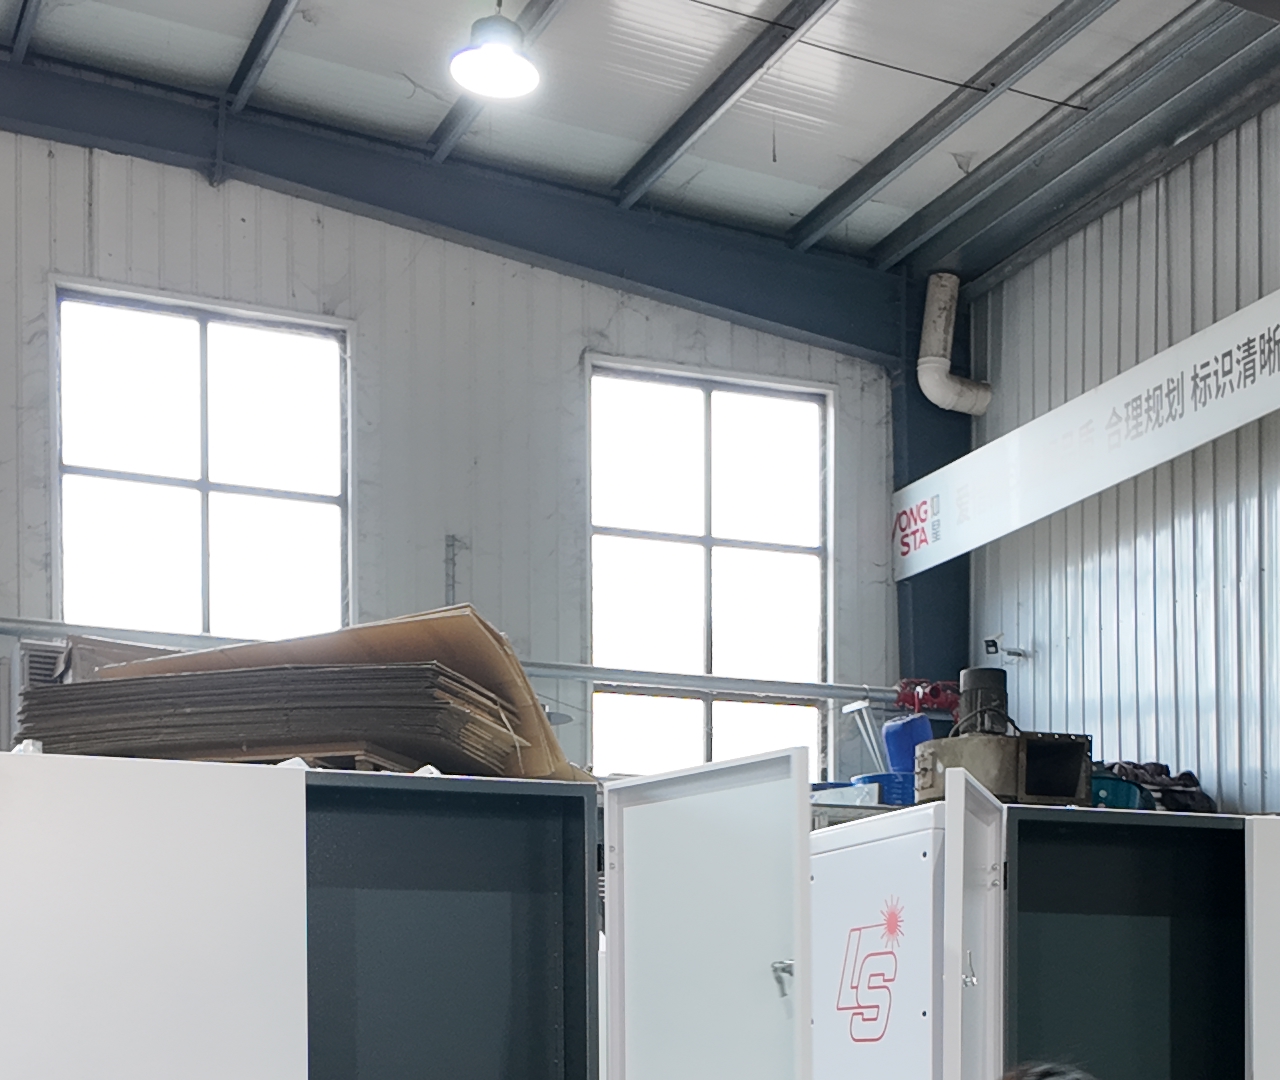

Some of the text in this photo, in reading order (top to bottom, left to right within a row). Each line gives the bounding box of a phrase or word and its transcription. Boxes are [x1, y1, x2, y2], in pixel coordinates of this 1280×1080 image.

[1104, 370, 1186, 453] 合理规划
[899, 526, 930, 558] STA
